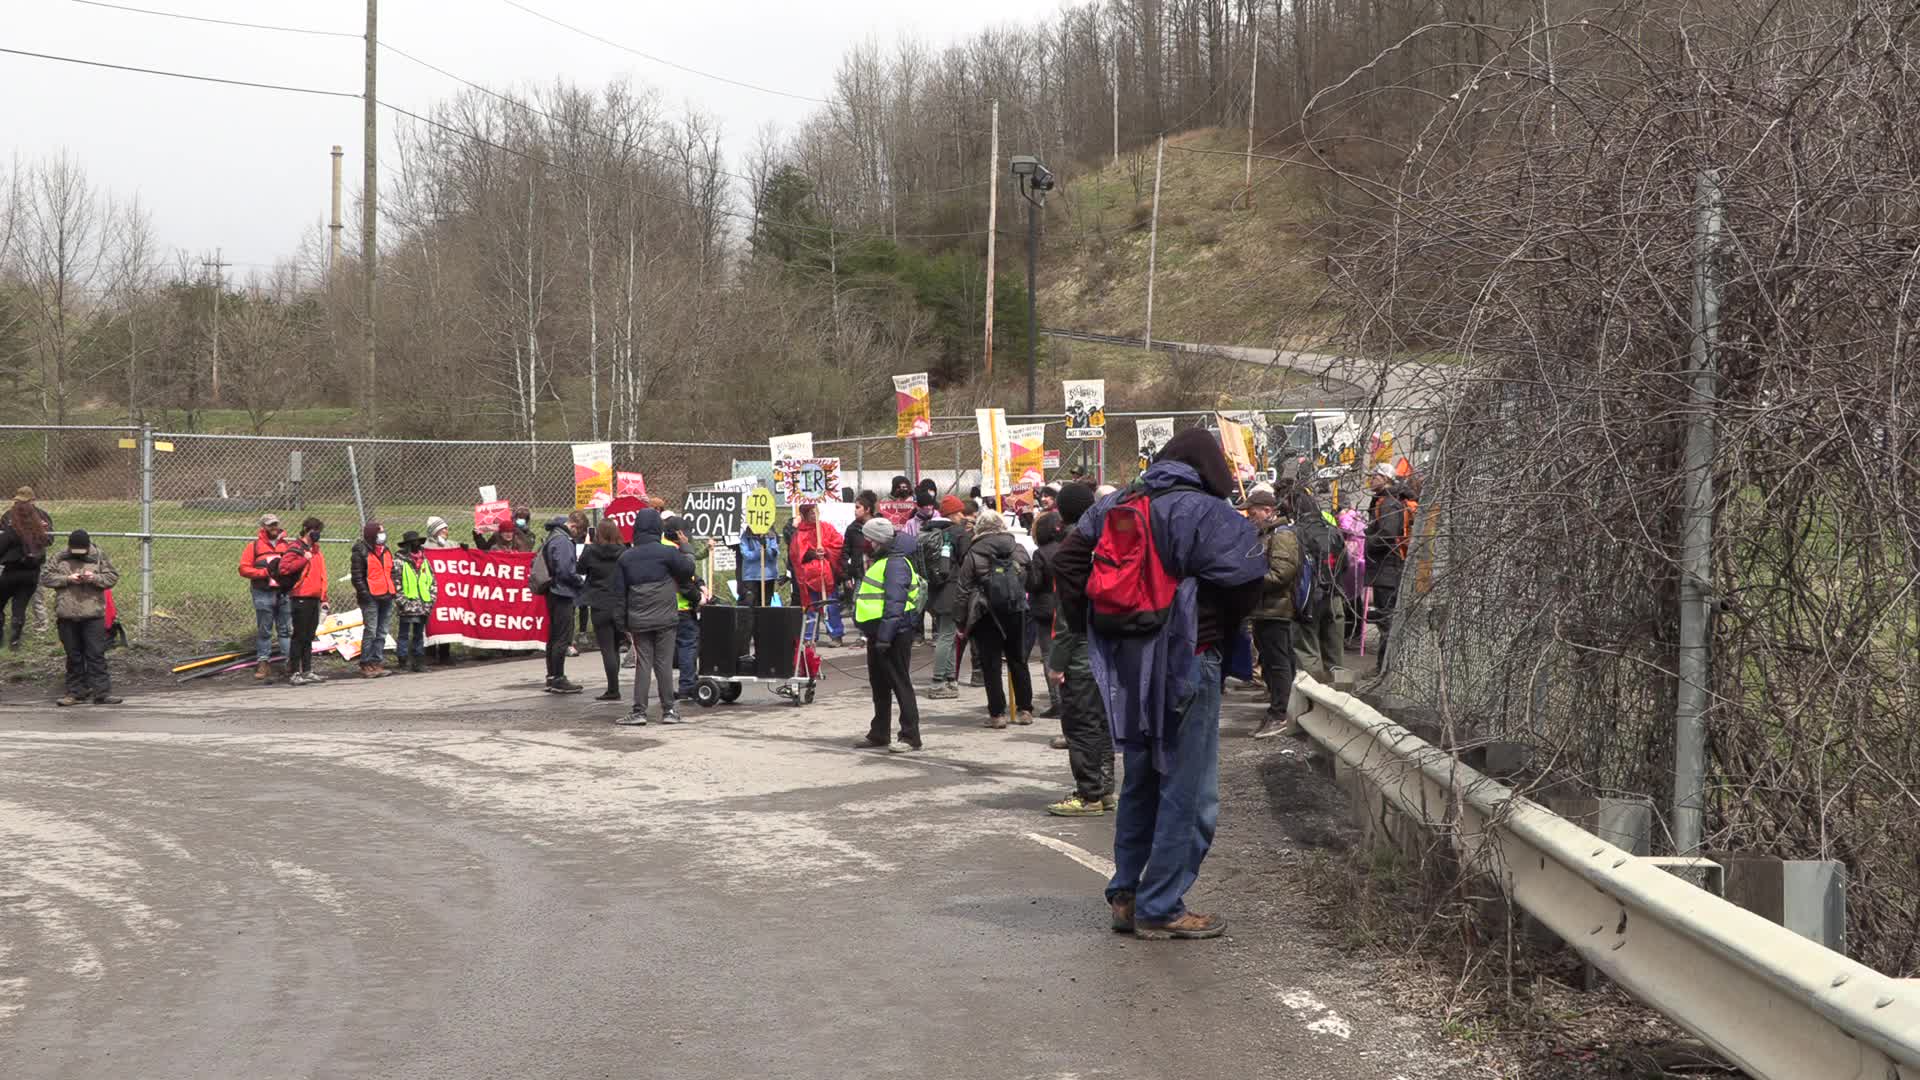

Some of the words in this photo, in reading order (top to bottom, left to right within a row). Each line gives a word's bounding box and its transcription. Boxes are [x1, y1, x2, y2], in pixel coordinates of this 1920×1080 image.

[791, 469, 833, 493] FIRE
[683, 492, 736, 512] Adding
[753, 494, 768, 507] TO
[608, 510, 640, 526] STO
[748, 510, 770, 526] THE
[433, 559, 526, 580] DECLARE
[444, 582, 533, 603] CLIMATE
[436, 606, 544, 631] EMRGENCY
